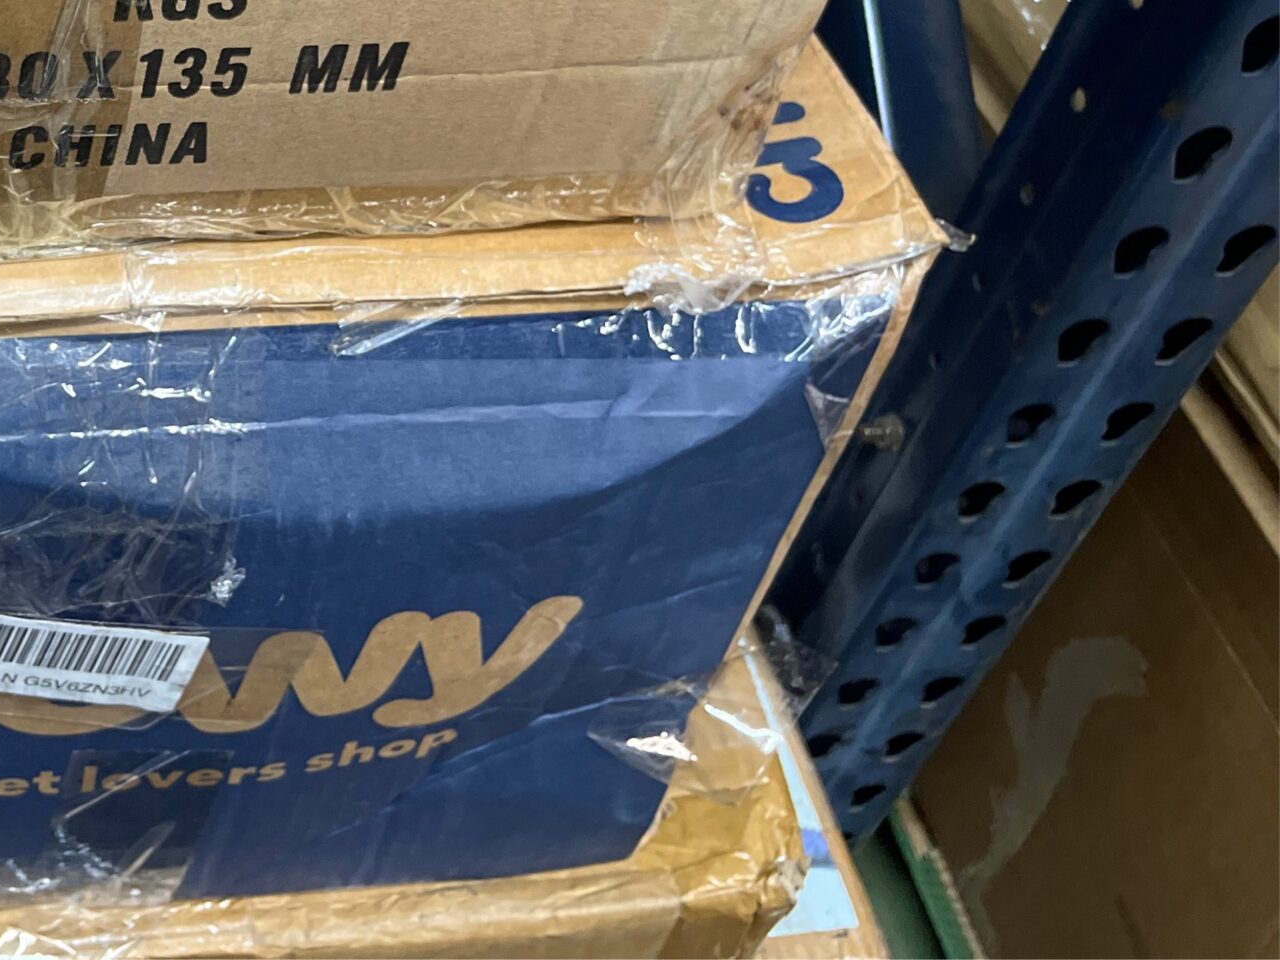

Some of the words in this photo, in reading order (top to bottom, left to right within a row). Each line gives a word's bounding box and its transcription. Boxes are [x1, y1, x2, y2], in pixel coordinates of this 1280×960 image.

[140, 46, 252, 99] 135
[288, 41, 410, 95] MM
[8, 120, 208, 171] CHINA
[1, 672, 19, 684] N
[79, 757, 288, 794] lovers
[304, 728, 459, 774] shop
